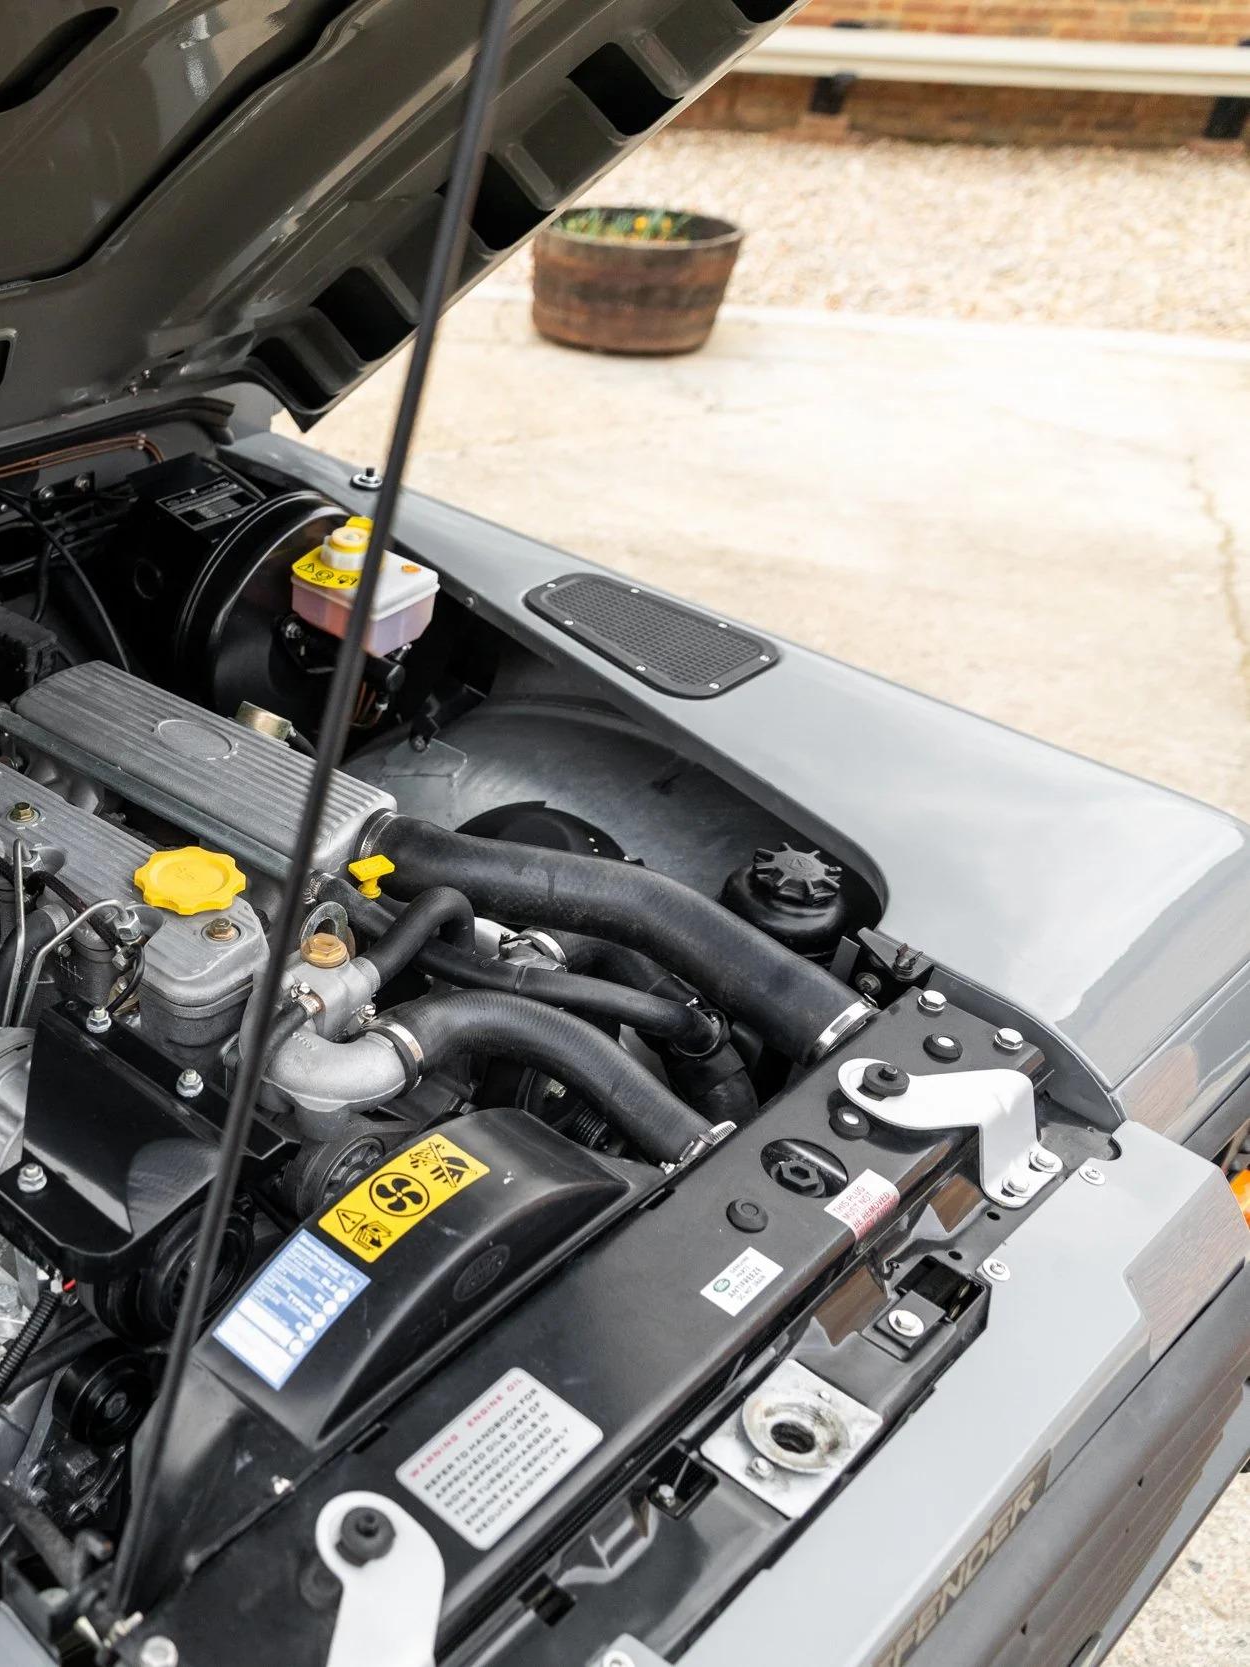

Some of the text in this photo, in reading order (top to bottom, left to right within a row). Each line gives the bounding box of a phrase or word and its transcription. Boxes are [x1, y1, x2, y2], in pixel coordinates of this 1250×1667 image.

[861, 1191, 891, 1220] REMOVED
[728, 1266, 762, 1299] ANTIFREEZE
[409, 1377, 523, 1477] WARNING ENGINE OIL
[423, 1387, 538, 1490] REFER TO HANDBOOK FOR
[433, 1452, 486, 1498] APPROVED
[509, 1413, 528, 1429] USE
[528, 1401, 542, 1412] OF
[444, 1412, 549, 1507] NON APPROVED OILS IN
[453, 1426, 552, 1515] THIS TURBOCHARGED
[464, 1427, 569, 1523] ENGINE MAY SERIOUSLY
[474, 1447, 568, 1533] REDUCE ENGINE LIFE
